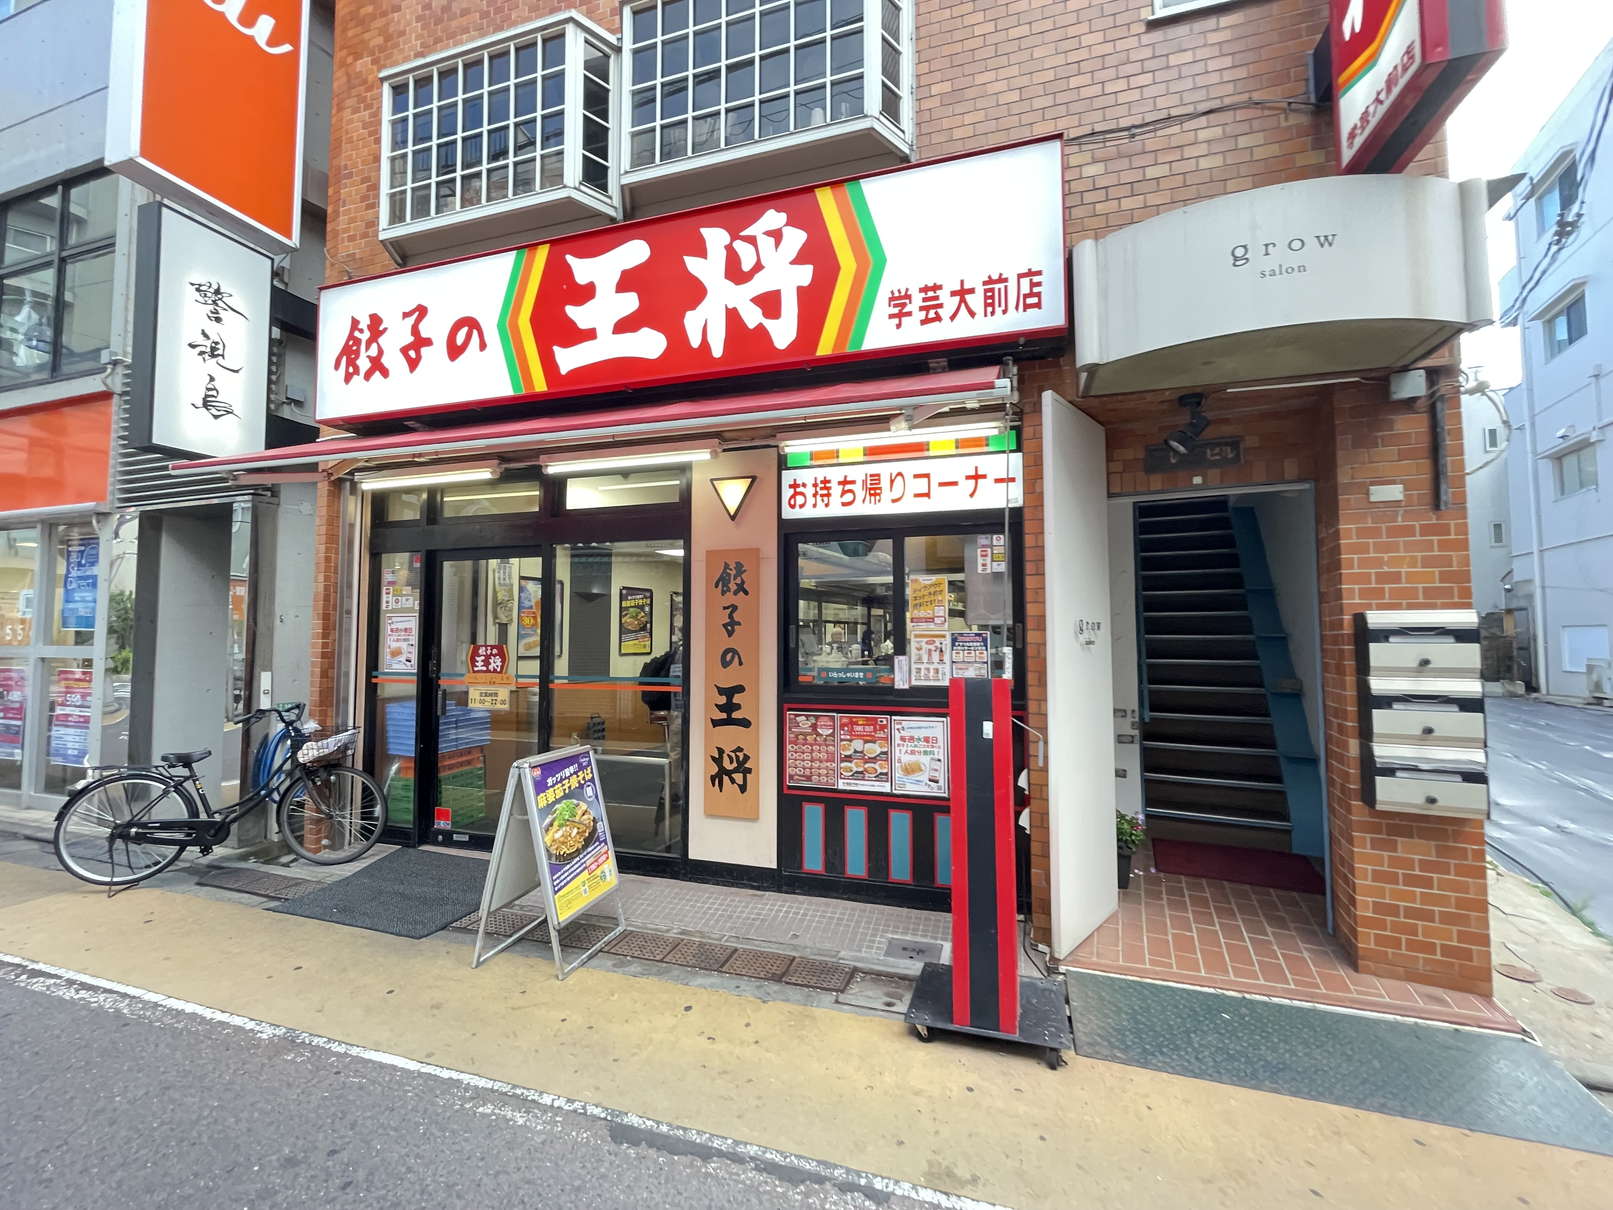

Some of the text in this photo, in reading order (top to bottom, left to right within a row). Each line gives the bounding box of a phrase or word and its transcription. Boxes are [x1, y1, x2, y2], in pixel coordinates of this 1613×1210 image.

[1229, 233, 1337, 267] grow
[1258, 262, 1308, 279] salon
[333, 208, 814, 386] 餃子の 王将
[887, 268, 1044, 329] 学芸大前店
[787, 466, 1017, 510] お持ち帰りコーナー
[473, 655, 502, 672] 王将
[709, 560, 753, 795] 餃子の王将
